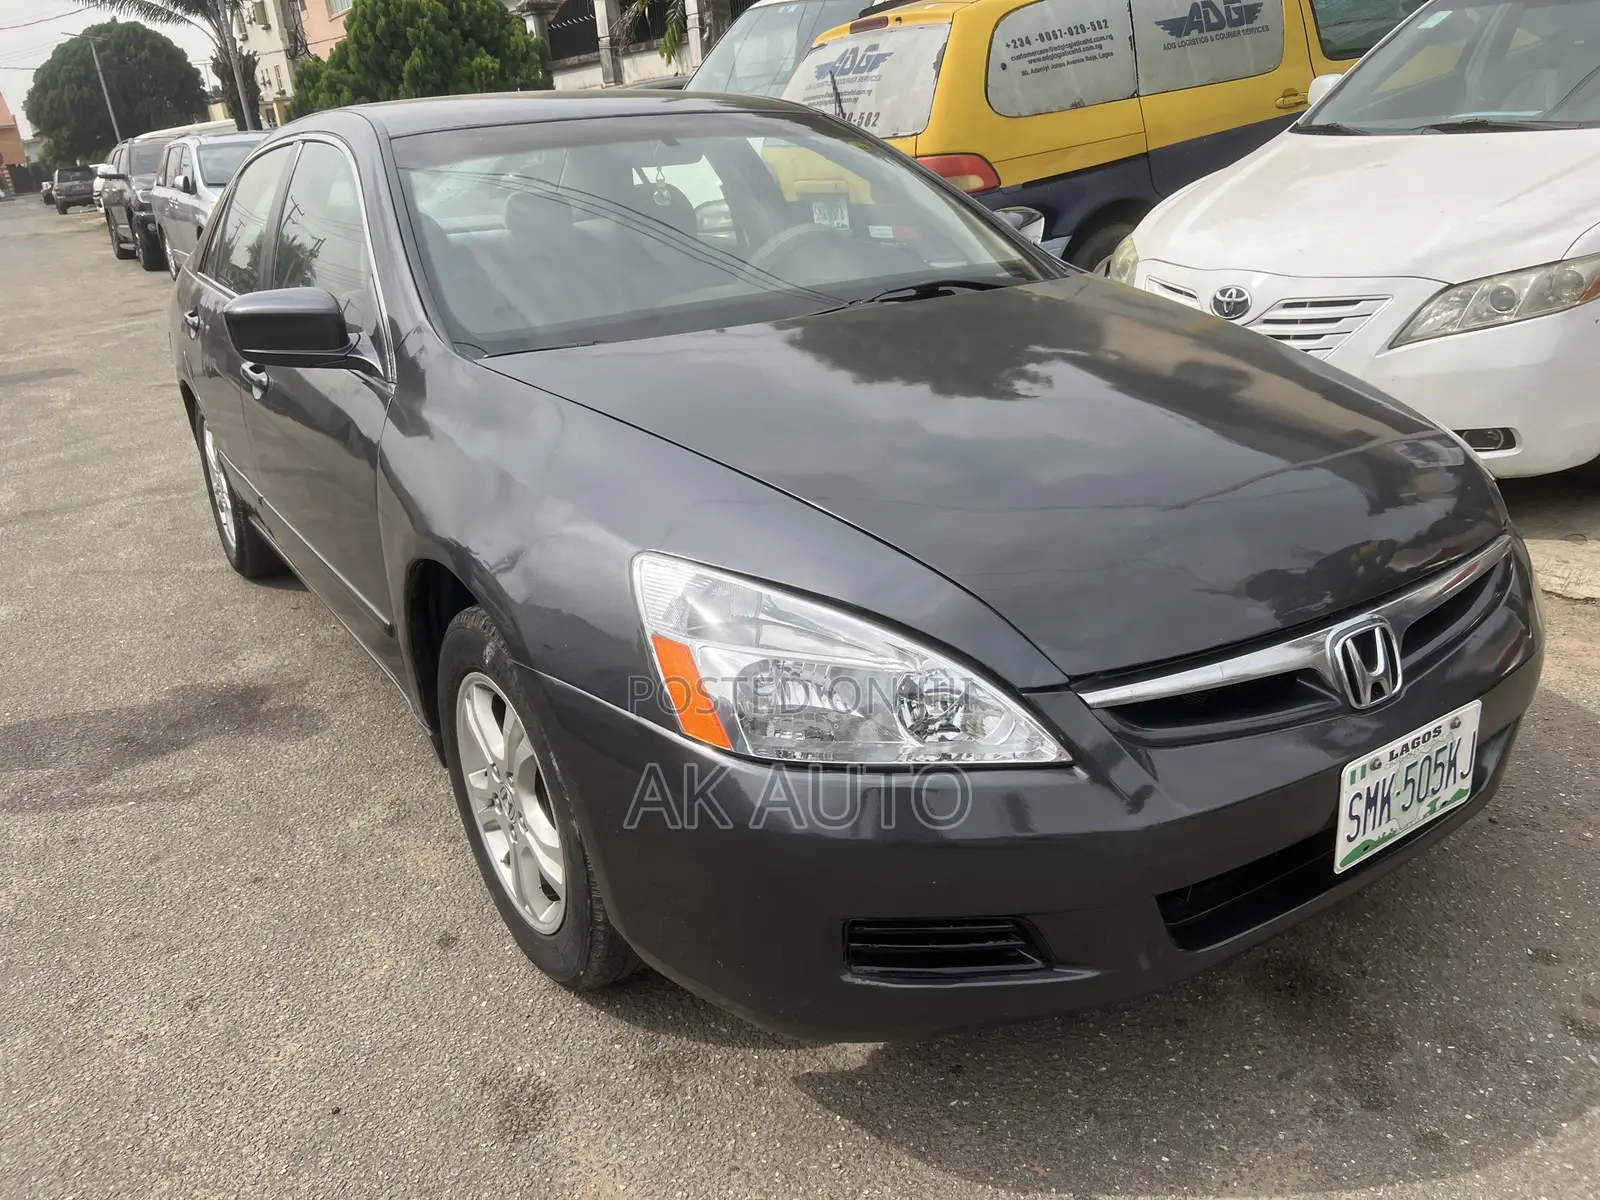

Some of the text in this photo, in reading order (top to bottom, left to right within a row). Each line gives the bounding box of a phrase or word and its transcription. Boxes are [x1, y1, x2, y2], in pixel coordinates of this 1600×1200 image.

[1181, 0, 1246, 38] ADG
[1005, 36, 1032, 49] +234
[1163, 41, 1177, 51] ADG
[1177, 36, 1209, 49] LOGISTICS
[1215, 29, 1241, 41] COURIER
[1242, 24, 1270, 36] SERVICES
[824, 43, 880, 77] ADG
[1388, 725, 1443, 762] LAGOS
[1346, 730, 1476, 843] SMK-505KJ
